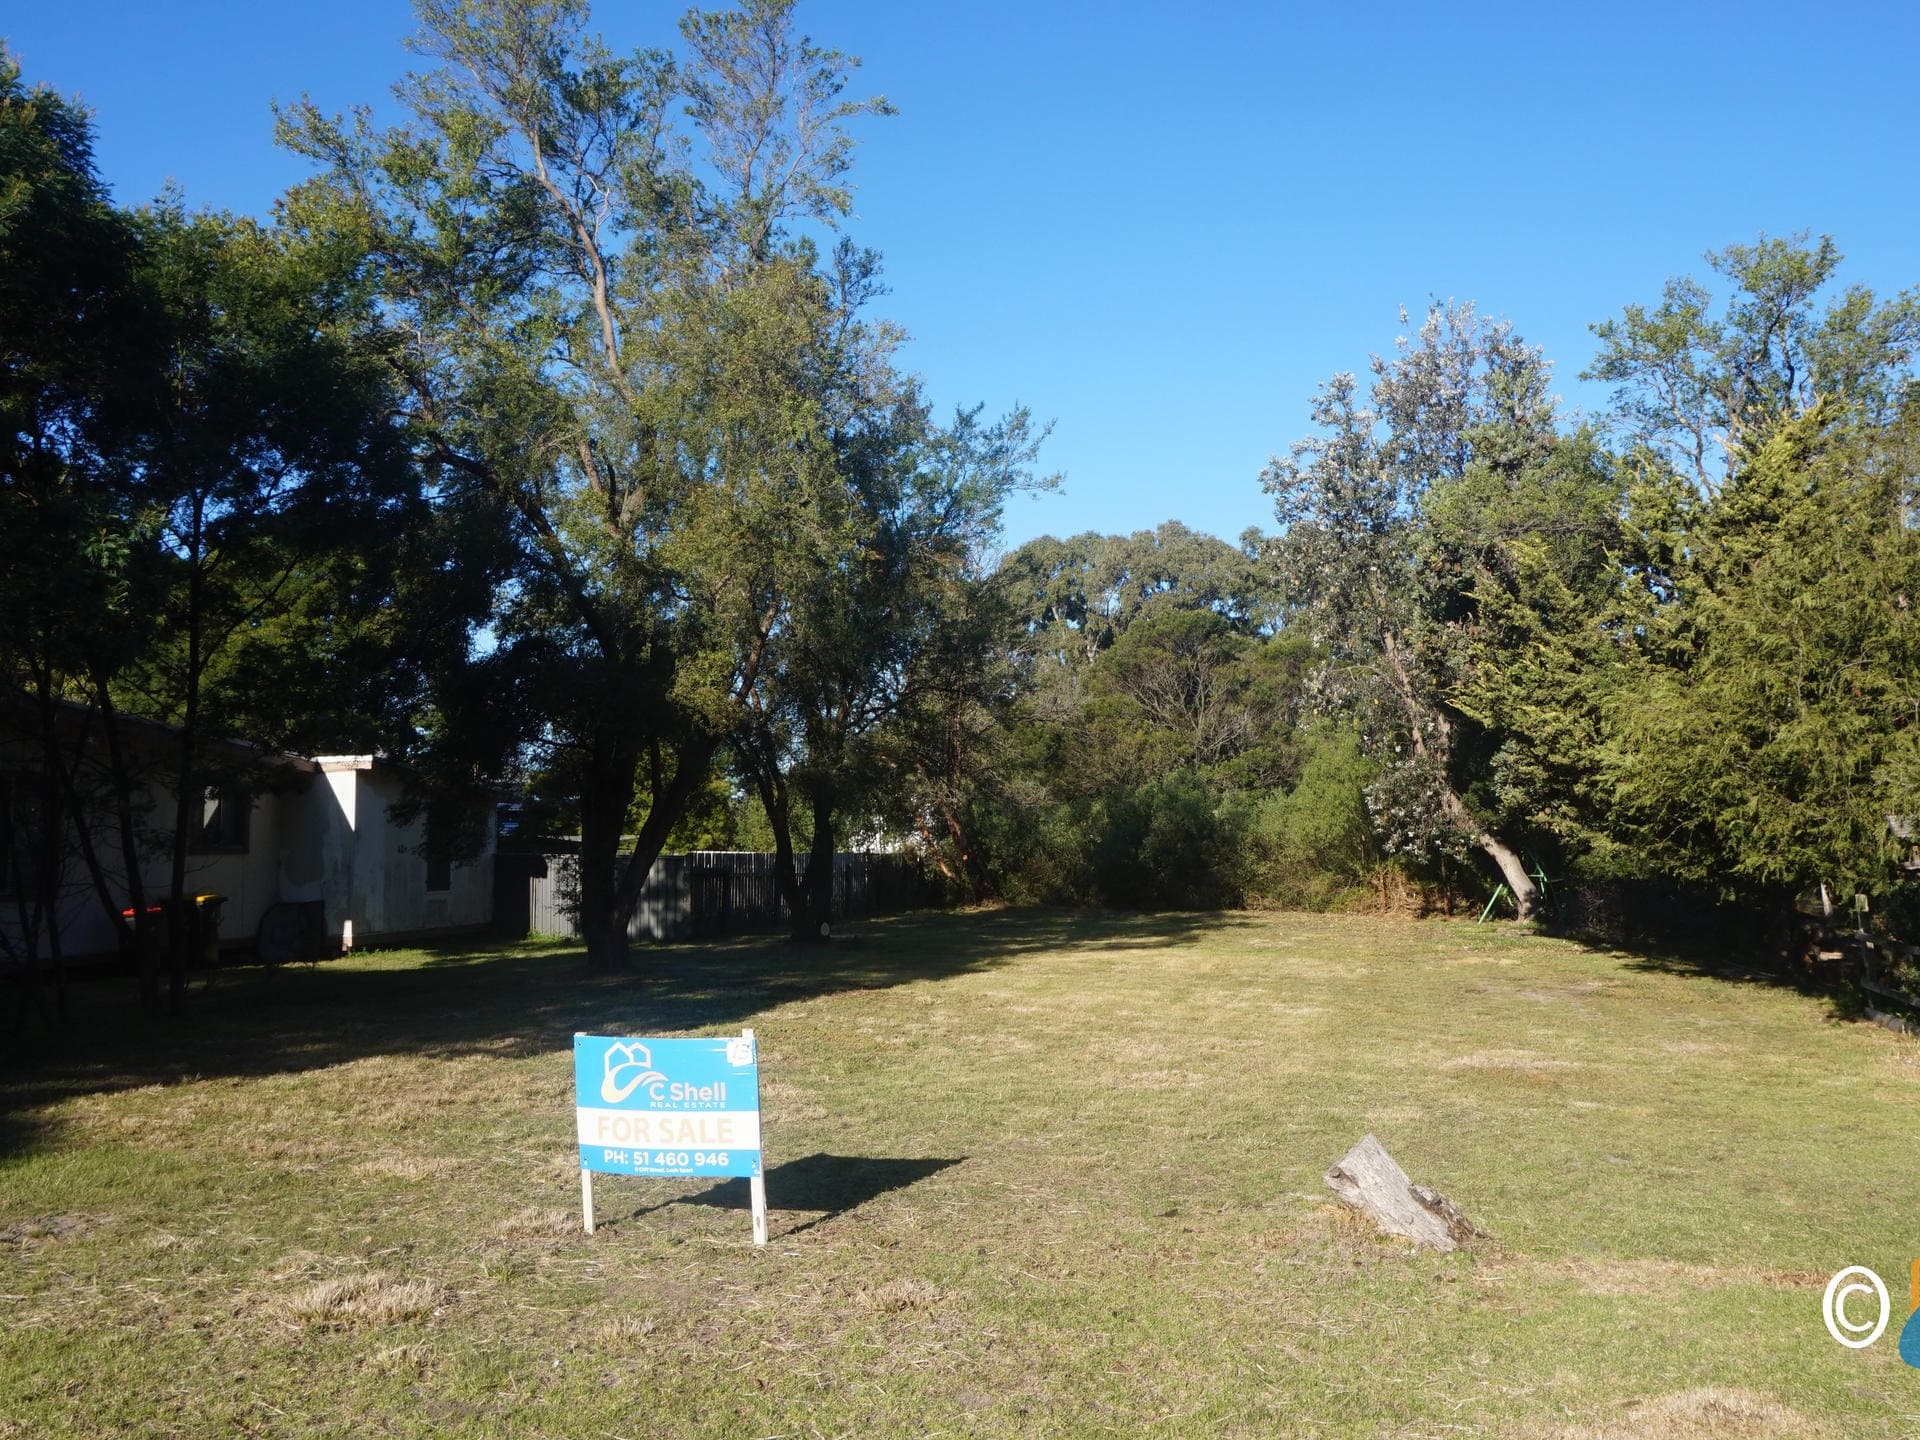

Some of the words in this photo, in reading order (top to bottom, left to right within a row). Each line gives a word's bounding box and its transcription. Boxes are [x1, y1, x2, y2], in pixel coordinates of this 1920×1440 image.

[649, 1082, 665, 1101] C
[669, 1081, 727, 1101] Shell
[650, 1101, 678, 1109] REAL
[683, 1101, 727, 1109] ESTATE
[597, 1116, 651, 1142] FOR
[658, 1118, 735, 1143] SALE
[603, 1149, 629, 1165] PH:
[633, 1151, 650, 1166] 51
[654, 1152, 689, 1166] 460
[694, 1152, 730, 1167] 946
